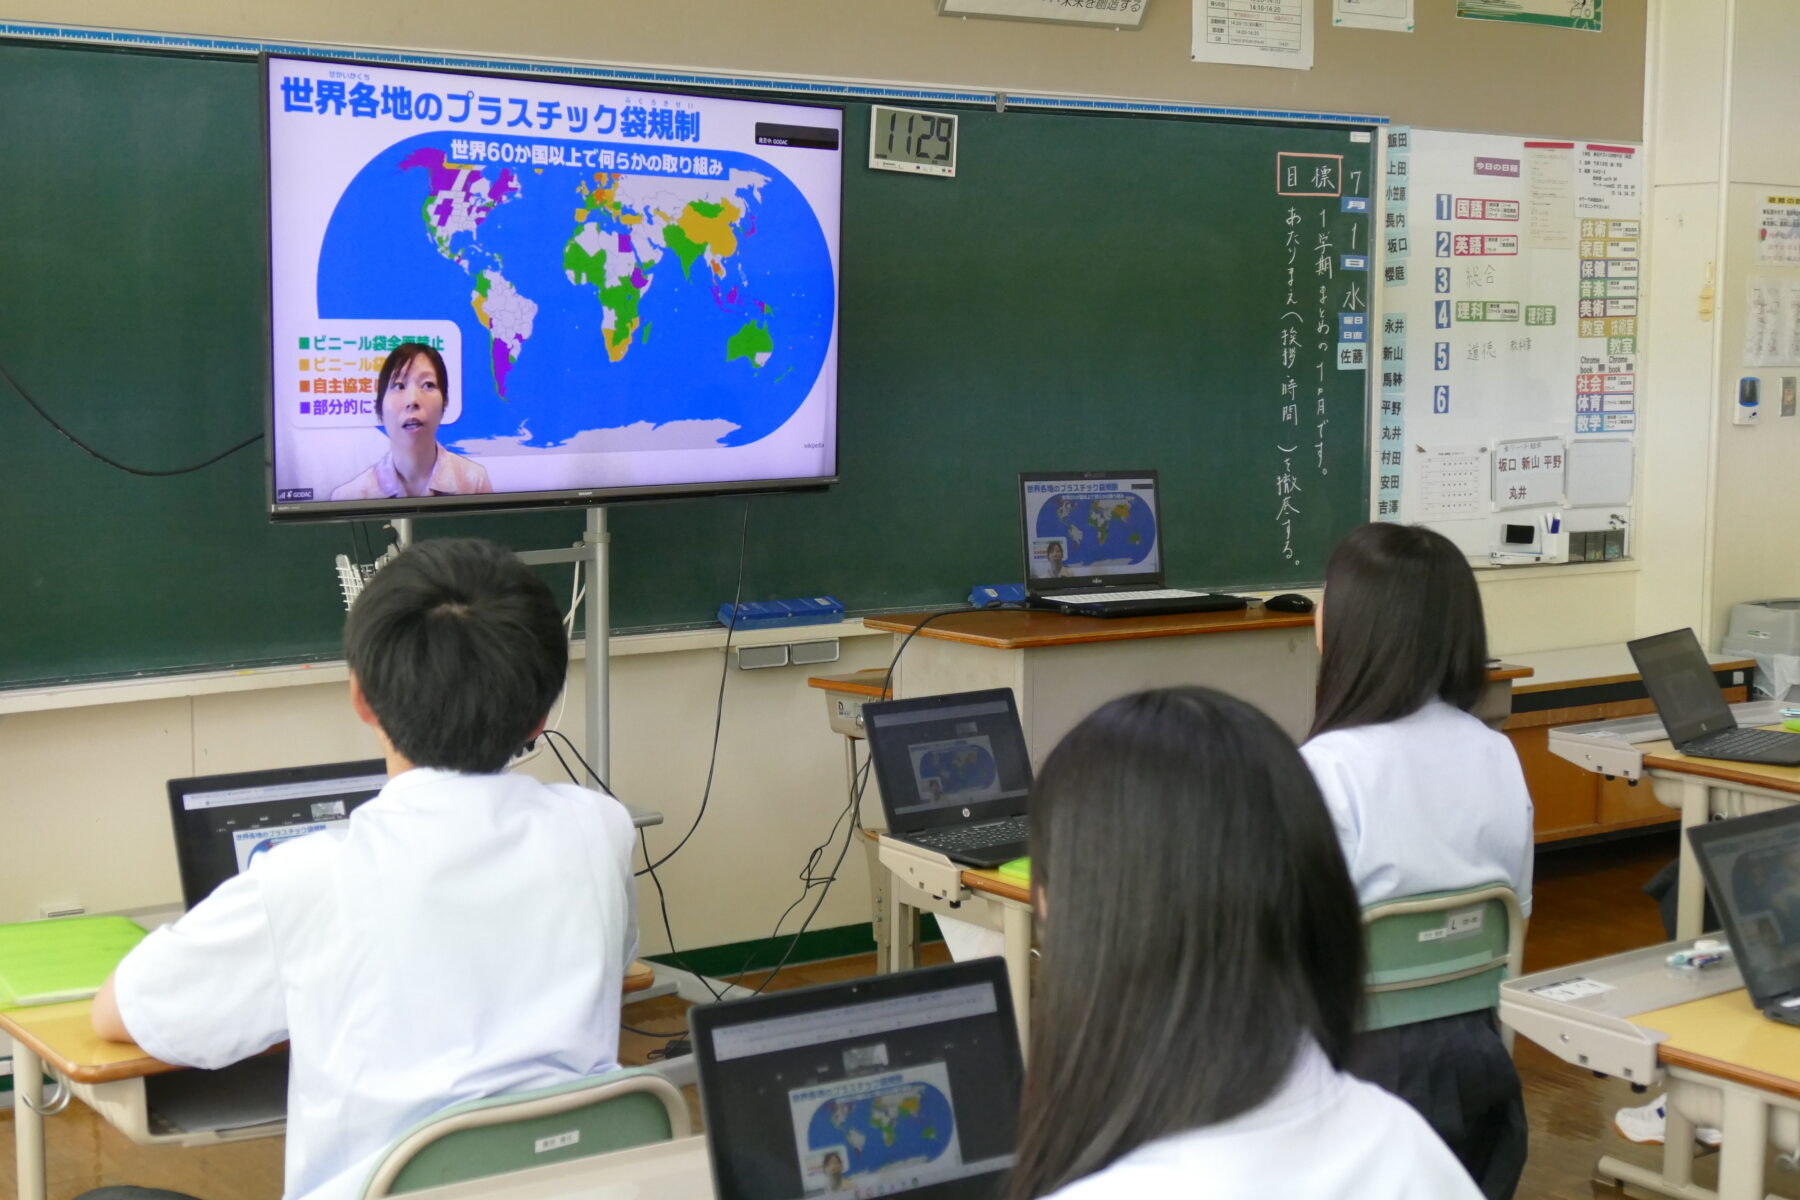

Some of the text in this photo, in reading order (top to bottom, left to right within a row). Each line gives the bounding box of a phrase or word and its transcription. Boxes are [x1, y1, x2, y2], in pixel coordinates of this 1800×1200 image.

[281, 76, 700, 142] 世界各地のプラスチック袋規制
[1387, 132, 1407, 148] 飯田
[451, 138, 723, 176] 世界60か国以上で何らかの取り組み
[1386, 160, 1407, 176] 上田
[1287, 165, 1335, 190] 目標
[1351, 171, 1362, 195] 7
[1441, 194, 1448, 220] 1
[1385, 213, 1405, 228] 長内
[1387, 238, 1408, 253] 坂口
[1438, 232, 1449, 257] 2
[1455, 236, 1482, 254] 英語
[1582, 260, 1606, 278] 保健
[1438, 268, 1448, 292] 3
[1342, 281, 1365, 311] 水
[1438, 301, 1448, 328] 4
[1457, 302, 1483, 320] 理科
[1580, 299, 1604, 317] 美術
[1384, 318, 1404, 334] 永井
[1581, 320, 1605, 336] 教室
[1383, 346, 1403, 361] 新山
[1610, 338, 1633, 354] 教室
[1340, 349, 1364, 365] 佐藤
[1437, 342, 1448, 370] 5
[1578, 375, 1602, 392] 社会
[313, 399, 377, 416] 部分的に
[1381, 400, 1401, 416] 平野
[1436, 386, 1447, 413] 6
[1577, 394, 1602, 411] 体育
[1381, 425, 1402, 440] 丸井
[1381, 450, 1401, 465] 村田
[1498, 455, 1562, 472] 坂口 新山 平野
[1380, 475, 1400, 489] 安田
[1508, 485, 1527, 500] 丸井
